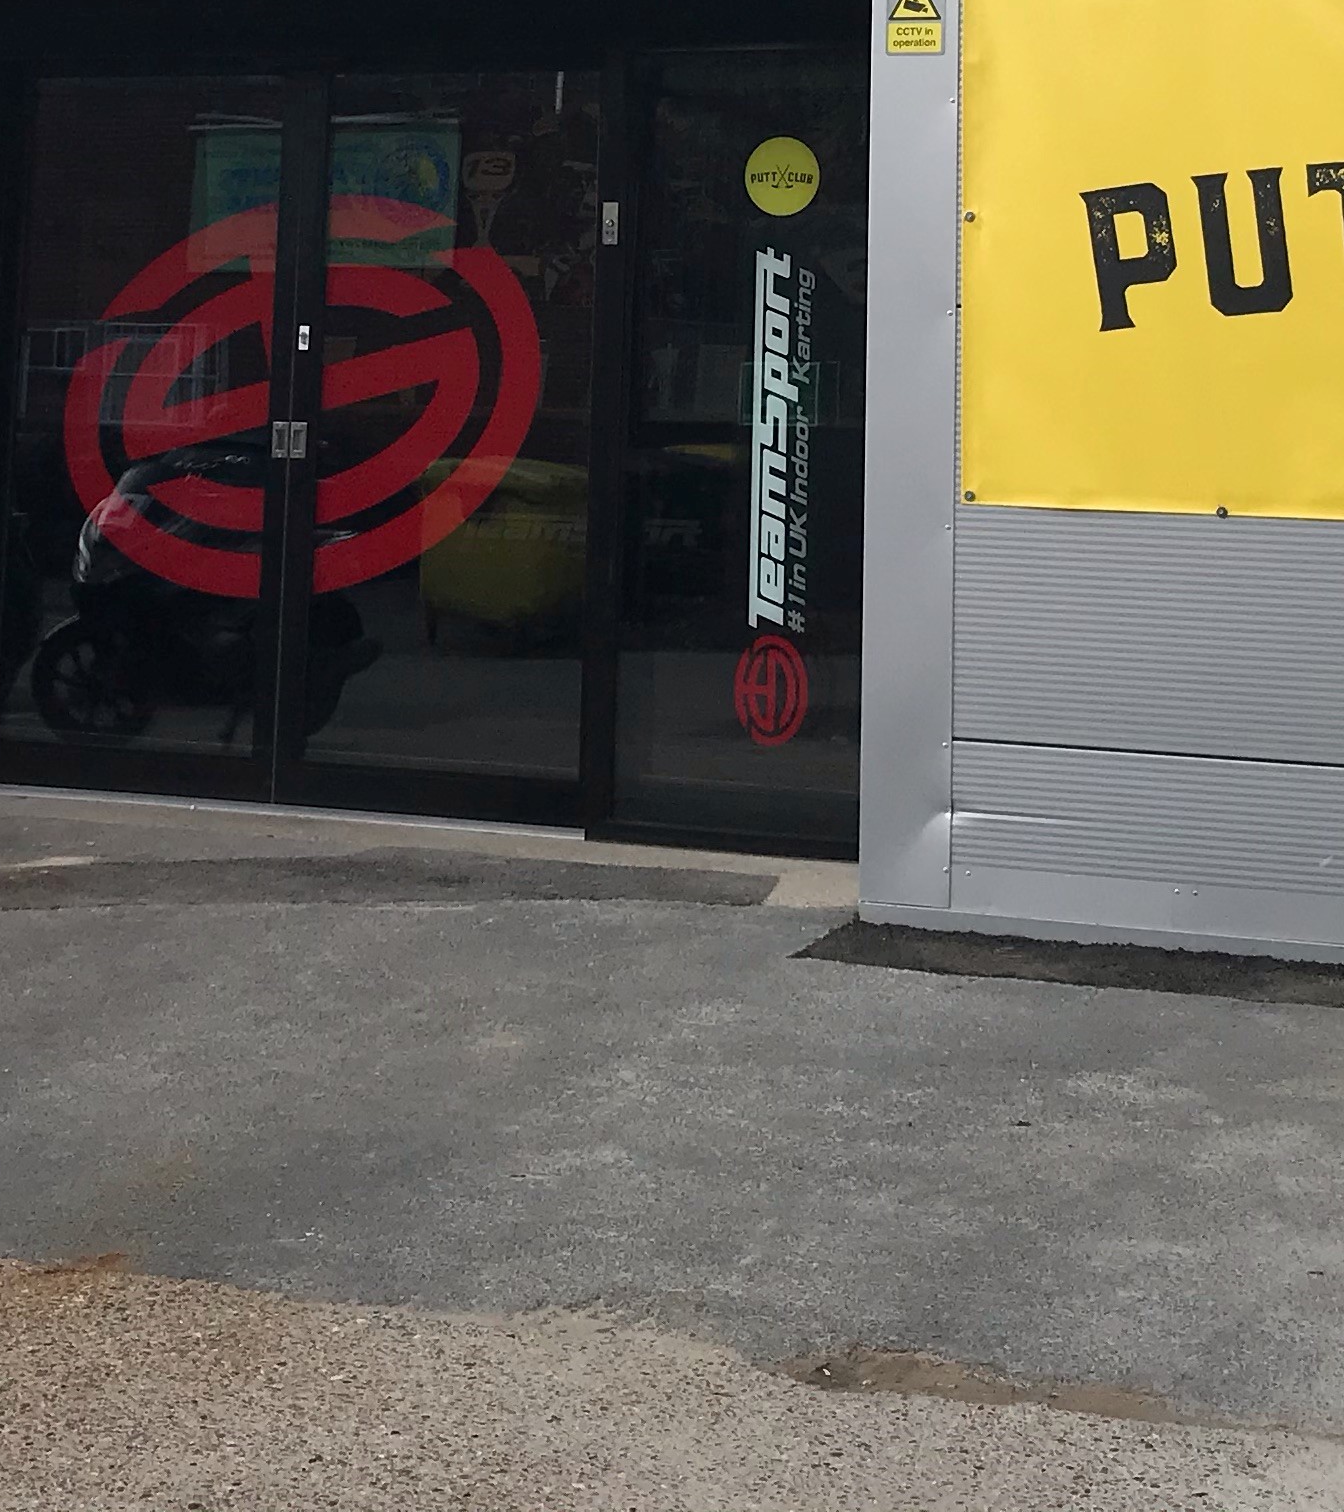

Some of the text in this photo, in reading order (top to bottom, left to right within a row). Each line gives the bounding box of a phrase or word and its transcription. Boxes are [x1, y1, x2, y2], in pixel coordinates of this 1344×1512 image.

[893, 39, 936, 48] operation
[896, 27, 933, 35] CCTV in
[750, 172, 814, 185] PUTT CLUB
[792, 268, 816, 384] Karting
[790, 406, 811, 506] Indoor
[789, 513, 810, 559] UK
[788, 562, 807, 589] in
